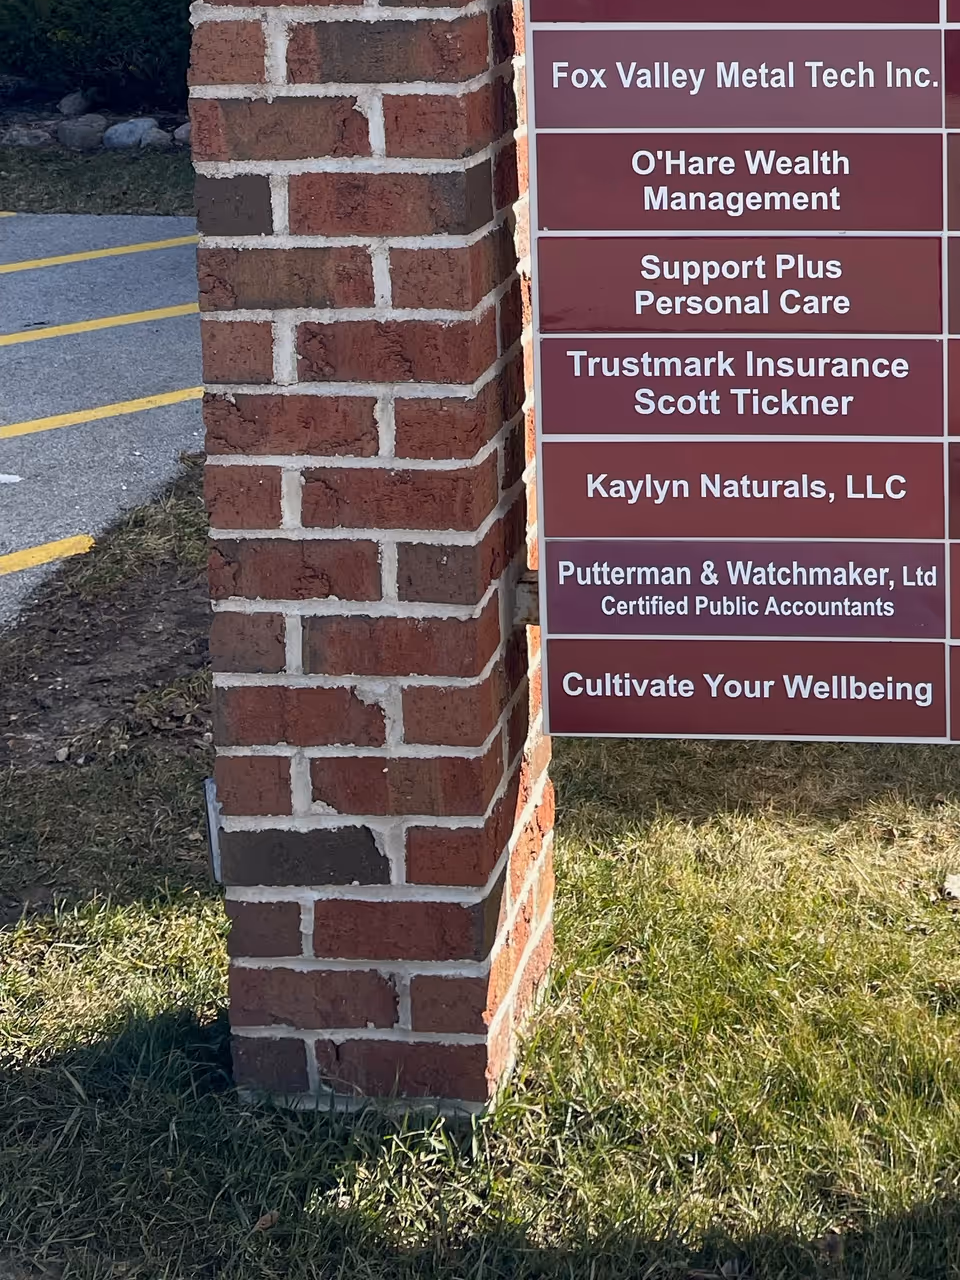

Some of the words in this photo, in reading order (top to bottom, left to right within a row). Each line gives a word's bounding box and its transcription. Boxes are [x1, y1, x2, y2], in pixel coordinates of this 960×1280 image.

[553, 62, 606, 88] Fox
[616, 62, 705, 95] Valley
[717, 62, 793, 87] Metal
[805, 62, 874, 87] Tech
[887, 62, 938, 87] Inc.
[632, 151, 735, 174] O'Hare
[745, 151, 849, 174] Wealth
[644, 186, 840, 216] Management
[641, 255, 766, 285] Support
[777, 255, 841, 278] Plus
[636, 290, 768, 314] Personal
[780, 290, 849, 314] Care
[567, 351, 735, 376] Trustmark
[747, 351, 908, 377] Insurance
[635, 389, 720, 414] Scott
[730, 389, 853, 415] Tickner
[587, 474, 688, 504] Kaylyn
[701, 474, 834, 503] Naturals,
[847, 475, 906, 499] LLC
[559, 561, 690, 585] Putterman
[701, 561, 719, 585] &
[727, 561, 894, 590] Watchmaker,
[903, 566, 936, 586] Ltd
[602, 596, 688, 615] Certified
[696, 596, 759, 615] Public
[765, 597, 894, 616] Accountants
[563, 672, 694, 697] Cultivate
[703, 674, 774, 697] Your
[783, 675, 932, 706] Wellbeing
